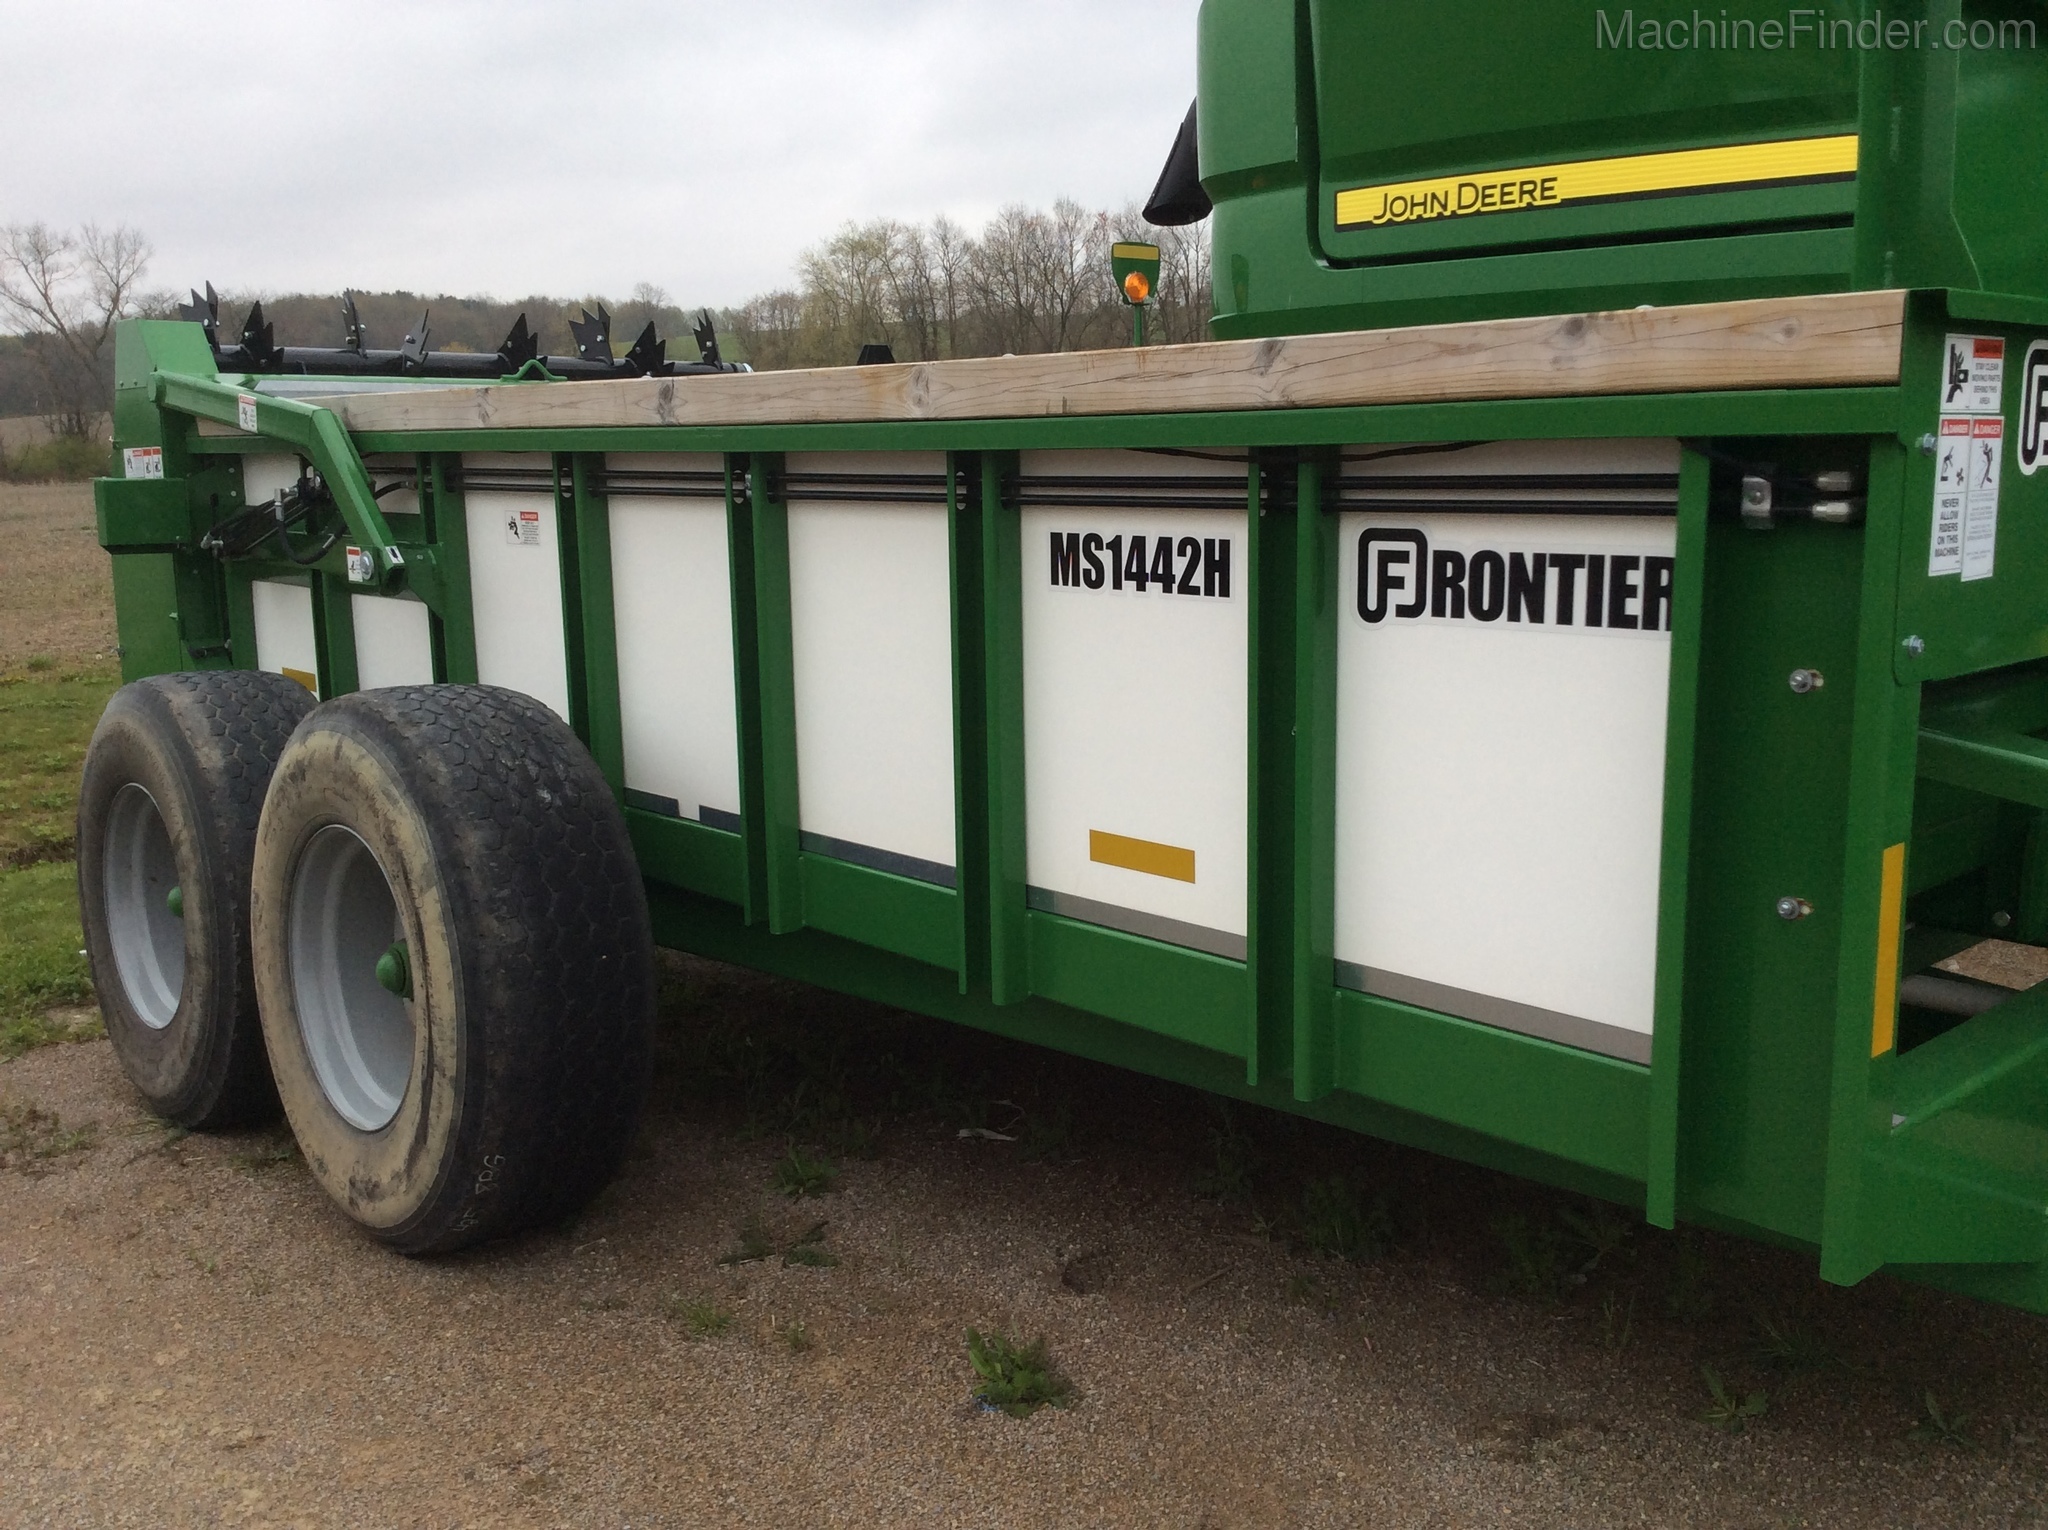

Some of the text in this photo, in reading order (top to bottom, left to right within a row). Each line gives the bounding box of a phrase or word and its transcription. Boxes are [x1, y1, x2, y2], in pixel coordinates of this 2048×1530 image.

[1373, 177, 1558, 221] JOHN DEERE
[1948, 424, 1969, 434] DANGER
[1979, 424, 2001, 435] DANGER
[1941, 498, 1959, 508] NEVER
[1940, 510, 1959, 520] ALLOW
[1938, 522, 1958, 533] RIDERS
[1936, 534, 1959, 546] ON THIS
[1934, 546, 1959, 557] MACHINE
[1050, 532, 1231, 598] MS1442H
[1357, 527, 1675, 632] FRONTIER
